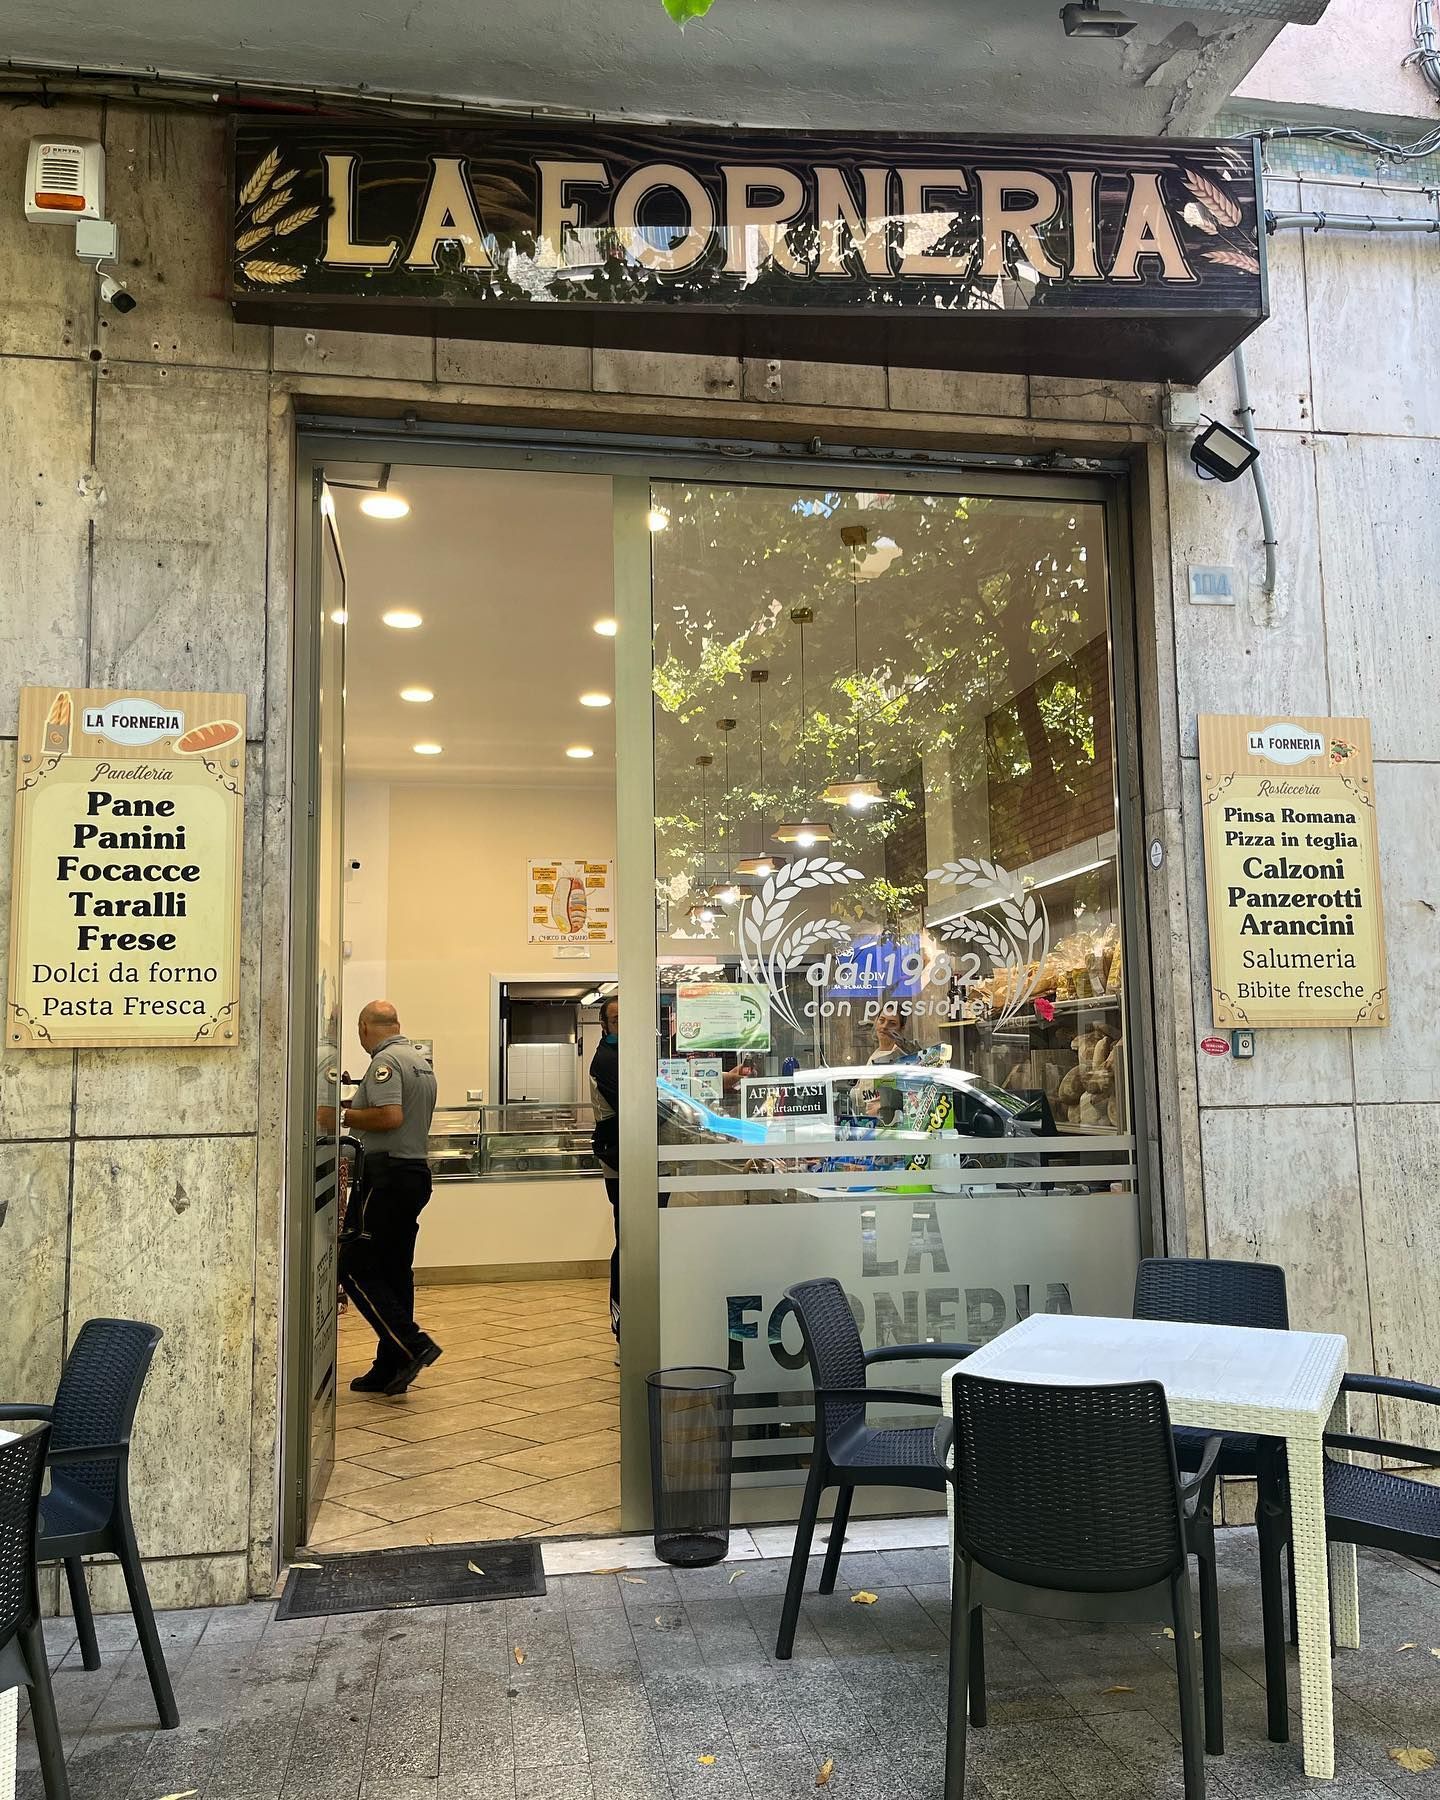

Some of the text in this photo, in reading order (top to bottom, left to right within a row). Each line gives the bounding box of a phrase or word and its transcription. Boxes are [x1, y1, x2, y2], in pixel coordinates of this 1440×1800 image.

[322, 155, 1199, 282] LA FORNERIA
[1192, 573, 1232, 596] 104
[86, 714, 180, 730] LA FORNERIA
[1250, 737, 1321, 750] LA FORNERIA
[90, 762, 174, 783] Panetteria
[1257, 779, 1321, 797] Rosticceria
[86, 791, 175, 817] Pane
[1223, 807, 1357, 824] Pinsa Romana
[73, 824, 186, 850] Panini
[1225, 831, 1358, 851] Pizza in teglia
[56, 856, 201, 882] Focacce
[1242, 857, 1345, 880] Calzoni
[68, 891, 187, 917] Taralli
[1228, 886, 1363, 908] Panzerotti
[1239, 914, 1355, 936] Arancini
[77, 926, 177, 951] Frese
[1243, 948, 1357, 969] Salumeria
[32, 962, 218, 983] Dolci da forno
[806, 952, 982, 987] dal 1982
[1237, 981, 1364, 999] Bibite fresche
[42, 996, 207, 1016] Pasta Fresca
[804, 1000, 852, 1018] con
[752, 1101, 822, 1117] Apartamenti
[860, 1201, 951, 1278] LA
